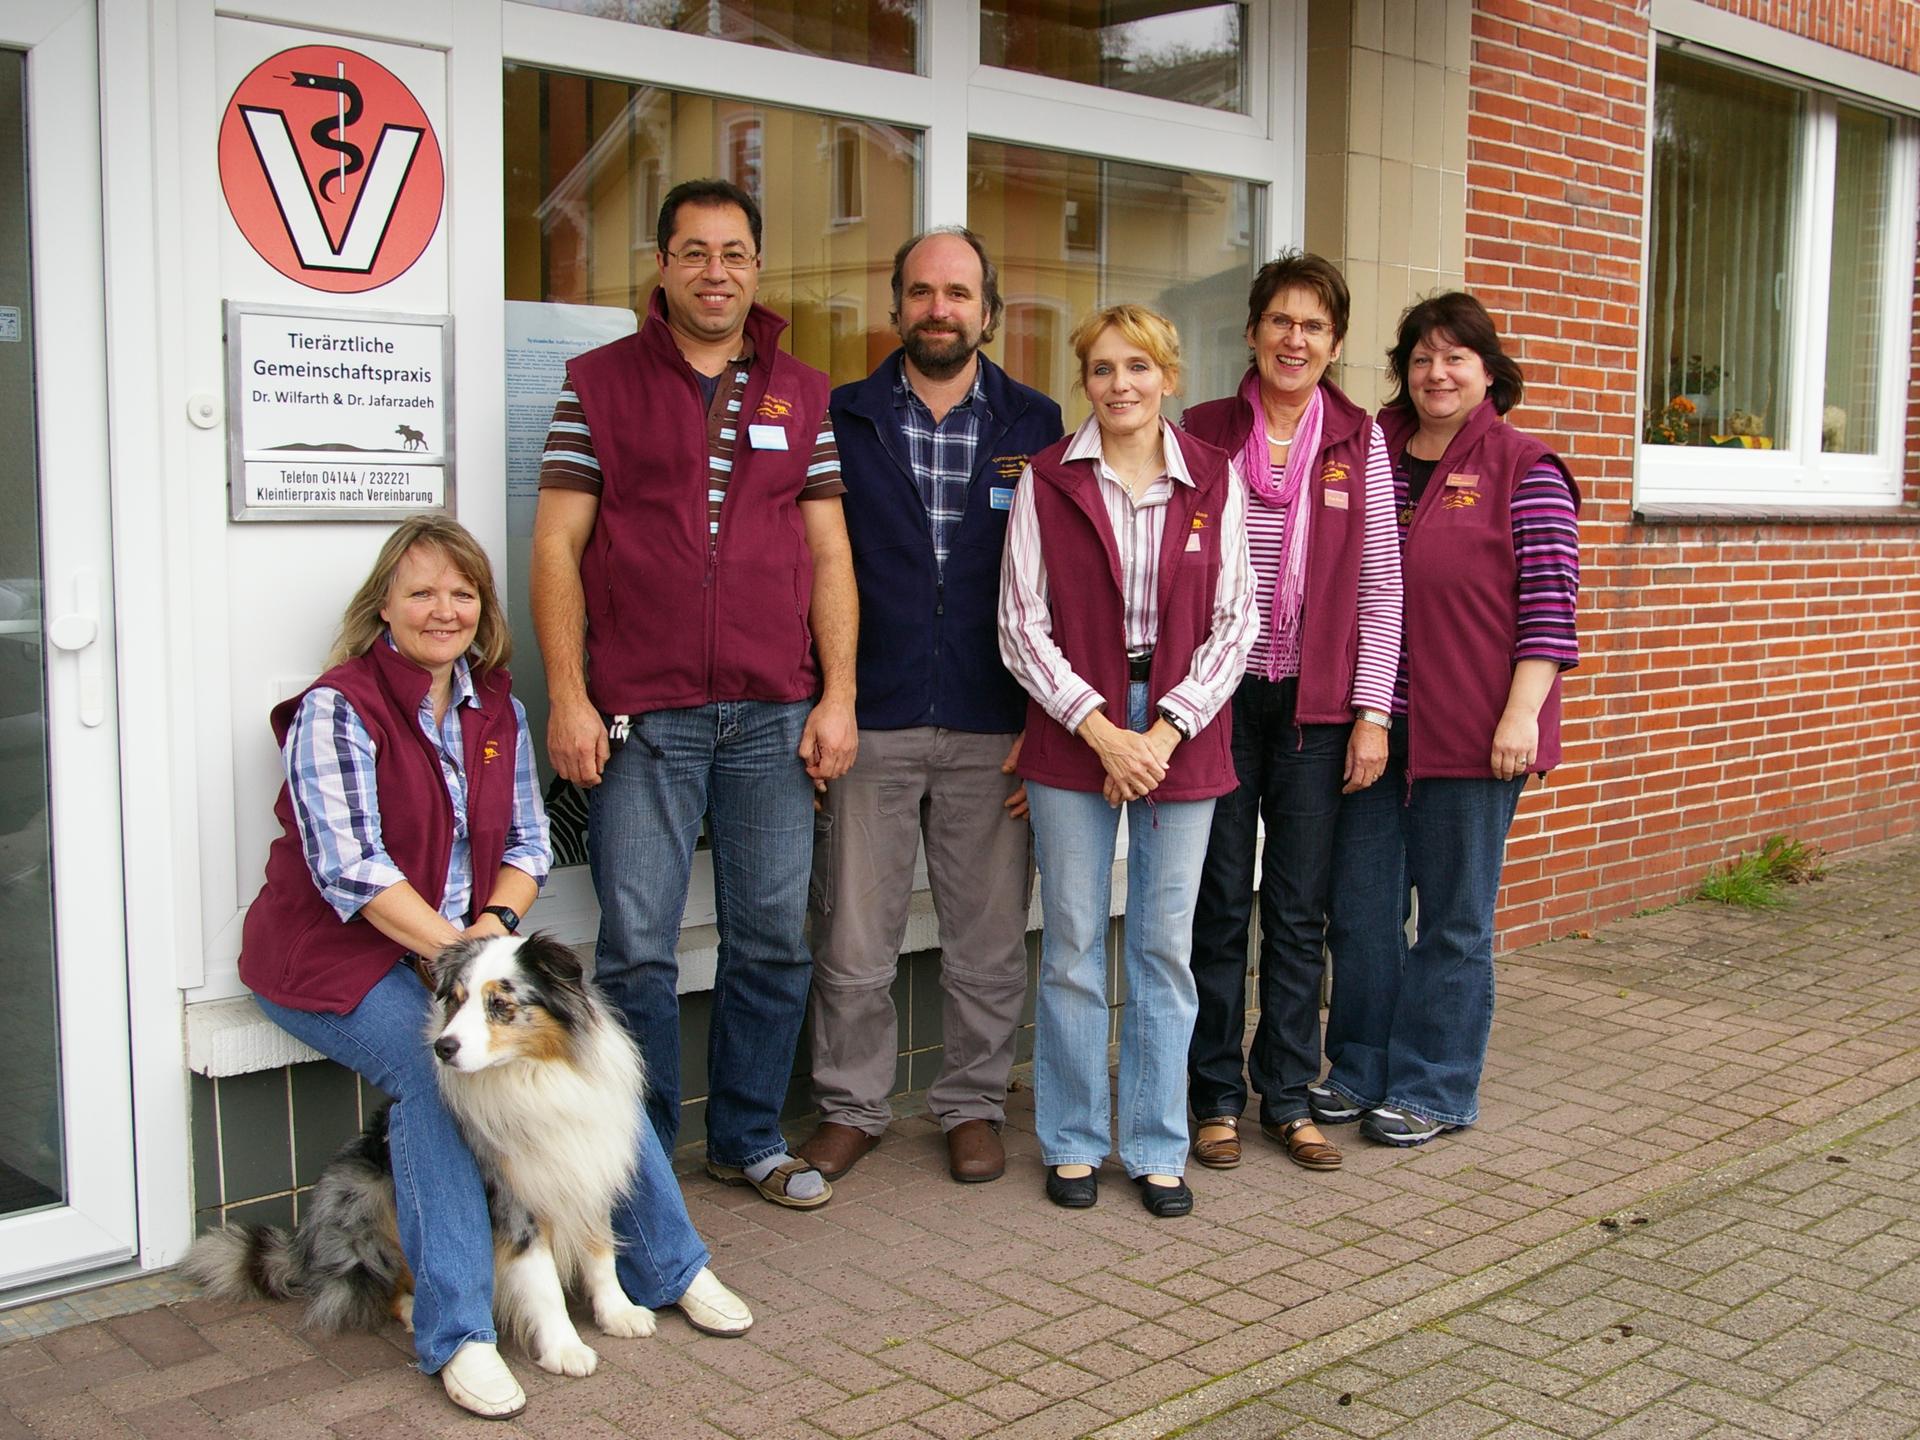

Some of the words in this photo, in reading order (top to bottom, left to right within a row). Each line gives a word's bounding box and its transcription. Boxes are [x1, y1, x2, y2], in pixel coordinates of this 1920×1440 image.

[238, 104, 426, 274] V
[288, 333, 394, 354] Tierärztliche
[253, 359, 432, 384] Gemeinschaftspraxis
[252, 390, 271, 403] Dr.
[275, 391, 329, 405] Wilfarth
[333, 393, 343, 405] &
[347, 394, 365, 406] Dr.
[368, 395, 435, 409] Jafarzadeh
[280, 470, 318, 484] Telefon
[322, 471, 357, 484] 04144
[369, 472, 410, 485] 232221
[257, 487, 336, 503] Kleintierpraxis
[340, 488, 364, 501] nach
[367, 488, 433, 503] Vereinbarung
